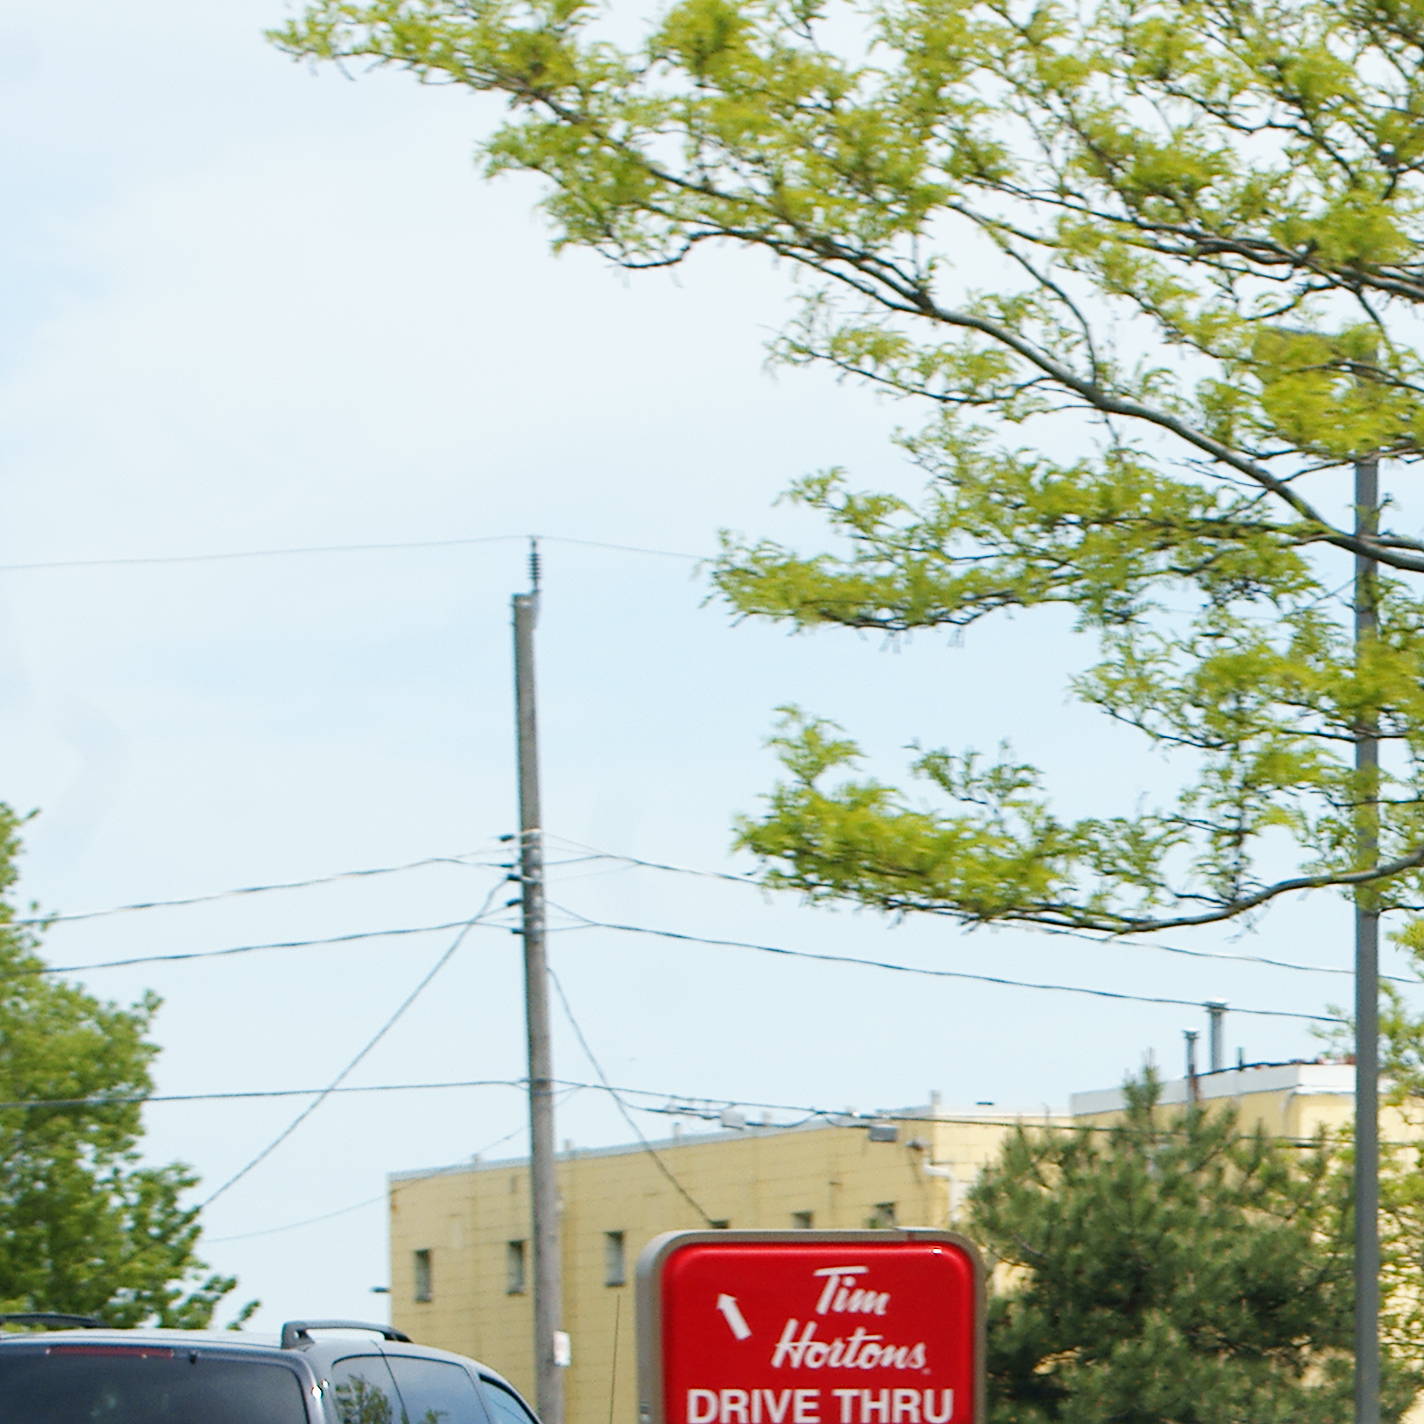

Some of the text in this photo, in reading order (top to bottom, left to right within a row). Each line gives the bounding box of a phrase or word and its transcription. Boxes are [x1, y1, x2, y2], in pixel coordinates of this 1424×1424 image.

[813, 1265, 890, 1316] Tim
[771, 1318, 927, 1370] Hortons
[686, 1388, 954, 1424] DRIVE THRU
